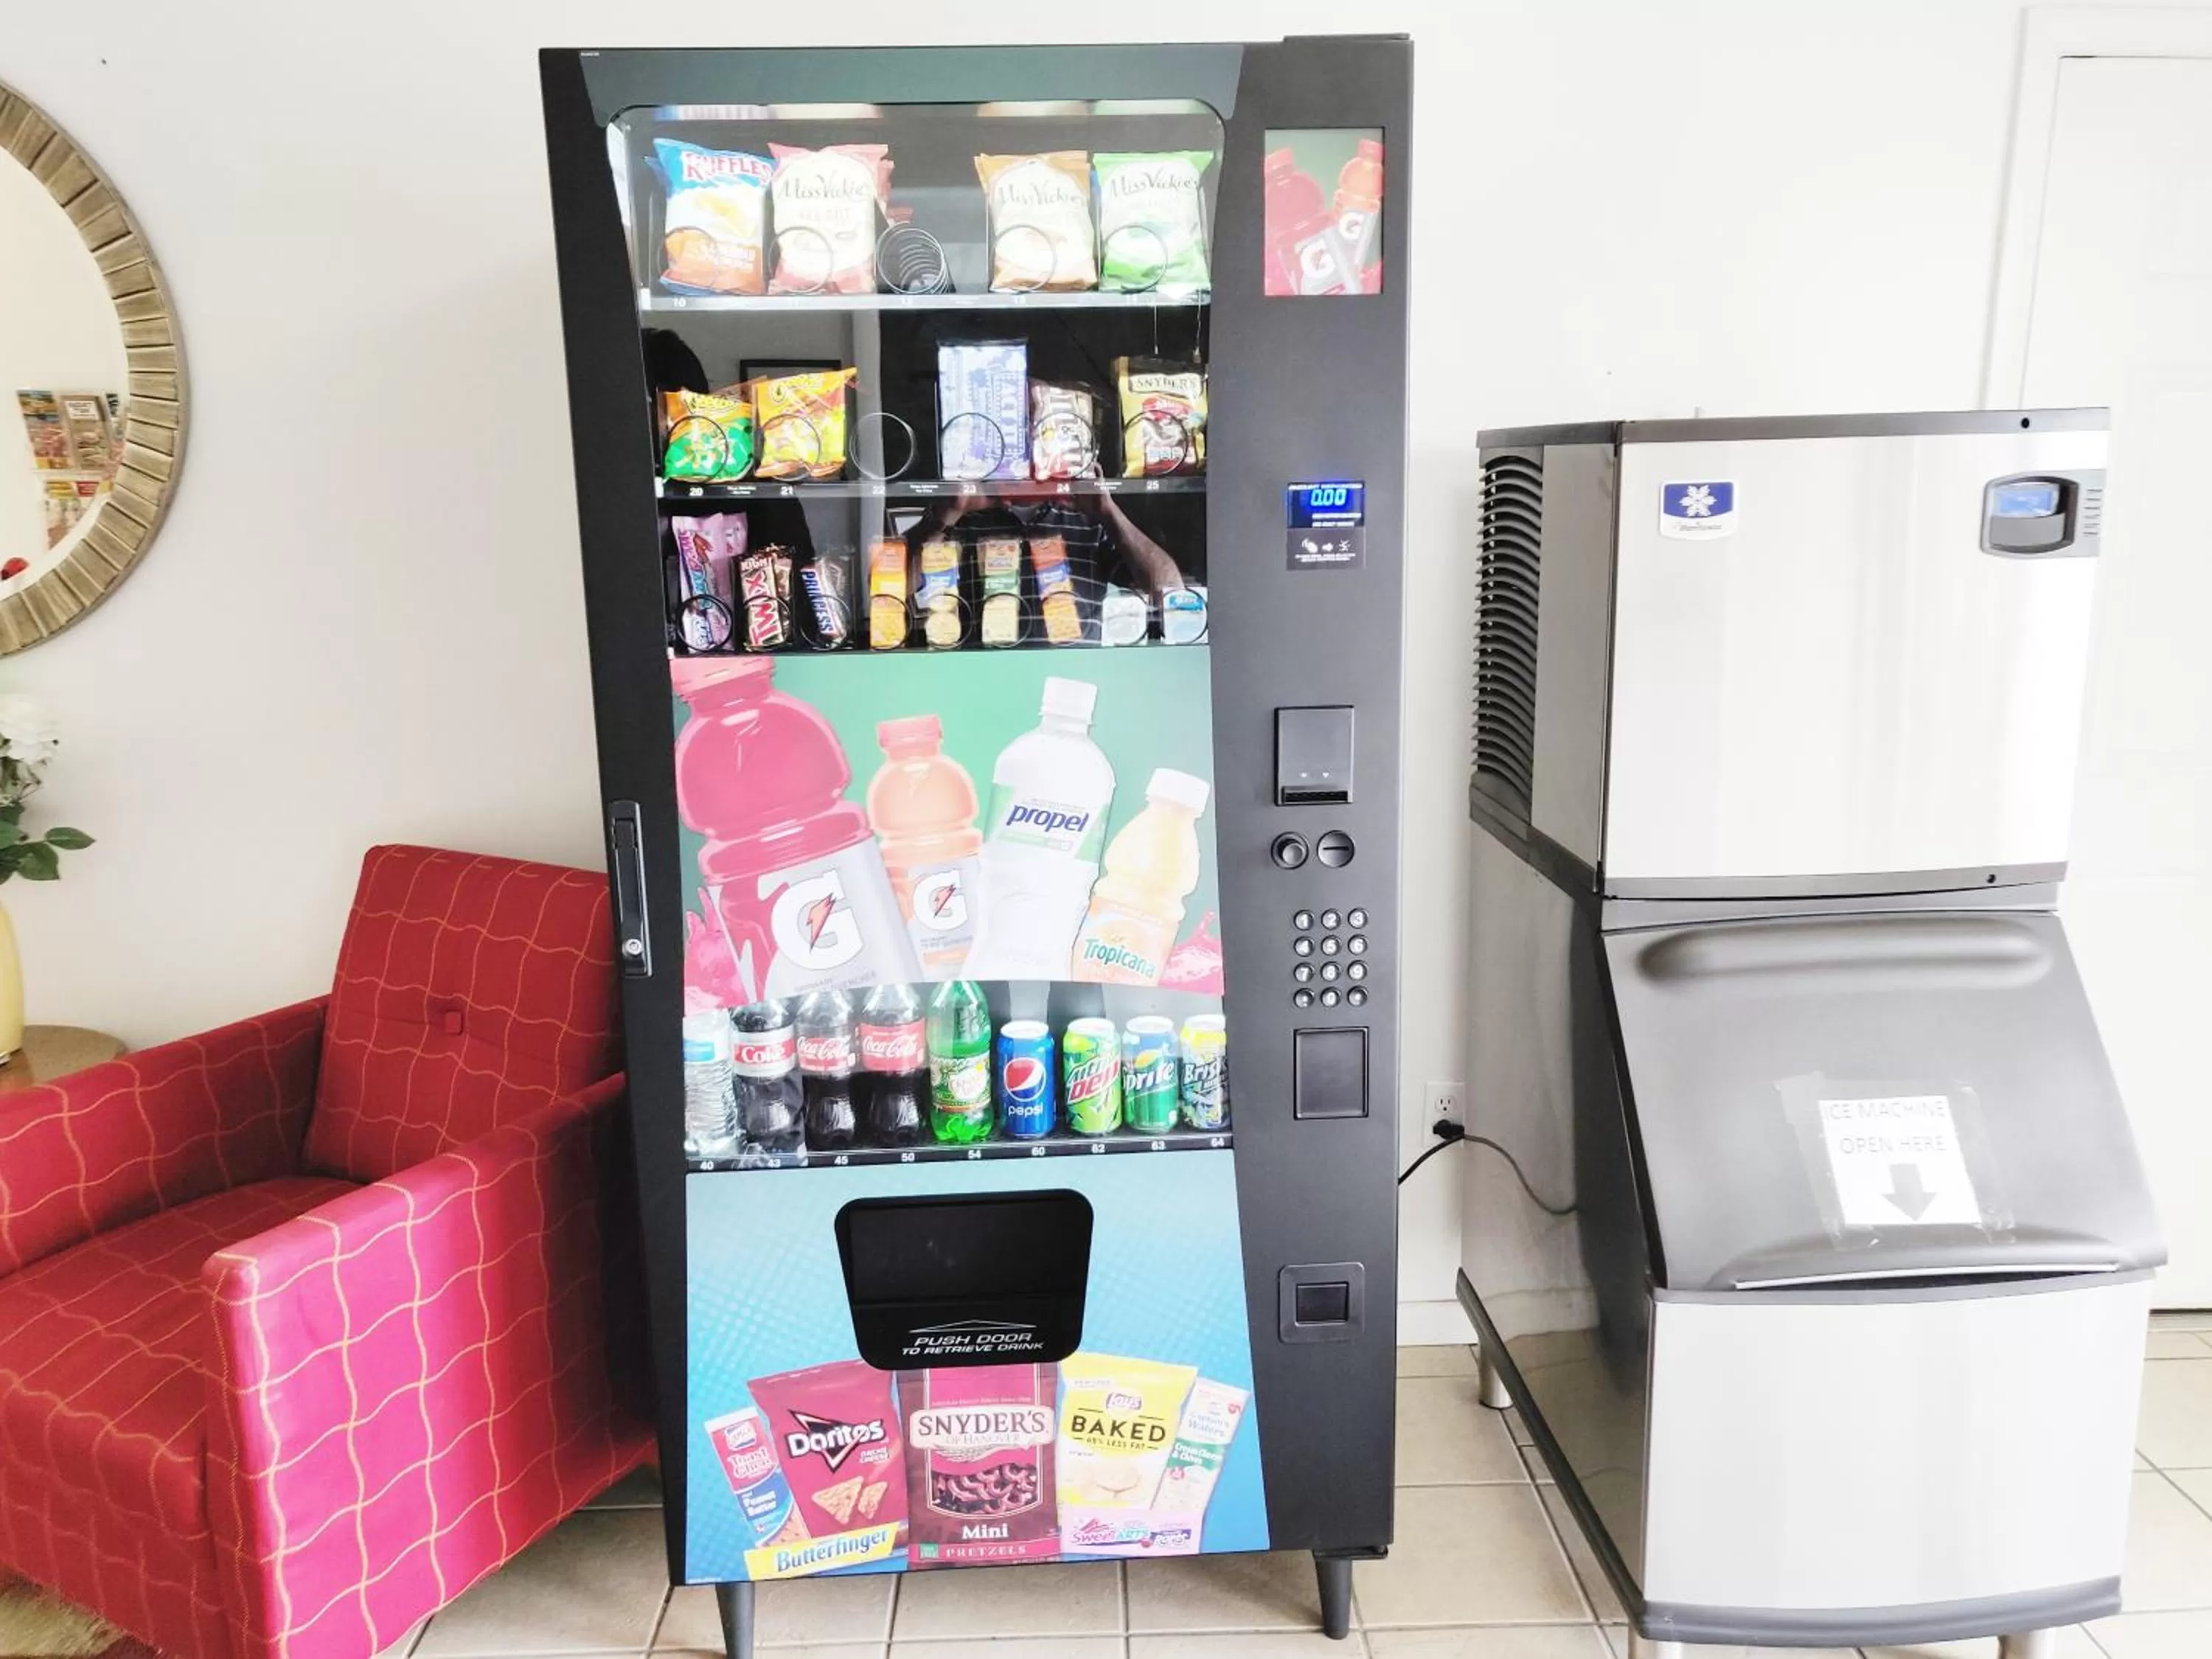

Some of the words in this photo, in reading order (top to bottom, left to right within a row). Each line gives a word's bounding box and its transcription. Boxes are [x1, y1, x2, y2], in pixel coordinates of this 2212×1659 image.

[684, 152, 771, 181] RUFFLES
[1301, 240, 1335, 278] G
[672, 297, 686, 307] 10
[689, 487, 703, 496] 20
[780, 486, 794, 495] 21
[963, 484, 977, 493] 23
[1056, 483, 1070, 493] 24
[1147, 480, 1160, 490] 25
[743, 570, 780, 647] TWIX
[1006, 804, 1090, 832] propel
[913, 869, 968, 931] G
[771, 869, 864, 971] G
[1083, 938, 1156, 979] Tropicana
[741, 1044, 785, 1063] Coke
[1008, 1105, 1043, 1117] pepsi
[1857, 1101, 1946, 1119] MACHINE
[1032, 1147, 1046, 1156] 60
[1091, 1144, 1105, 1155] 62
[1151, 1141, 1166, 1151] 63
[1840, 1136, 1893, 1155] OPEN
[1899, 1135, 1947, 1152] HERE
[834, 1155, 849, 1166] 45
[901, 1152, 915, 1163] 50
[968, 1150, 981, 1160] 54
[700, 1161, 714, 1171] 40
[914, 1335, 970, 1347] PUSH
[975, 1332, 1032, 1343] DOOR
[902, 1347, 921, 1355] TO
[923, 1344, 992, 1354] RETRIEVE
[996, 1341, 1044, 1351] DRINK
[918, 1411, 1046, 1436] SNYDER'S
[1071, 1415, 1166, 1442] BAKED
[786, 1419, 886, 1458] Doritos
[961, 1523, 1009, 1540] Mini
[776, 1530, 887, 1573] Butterfinger
[946, 1545, 1026, 1558] PRETZELS
